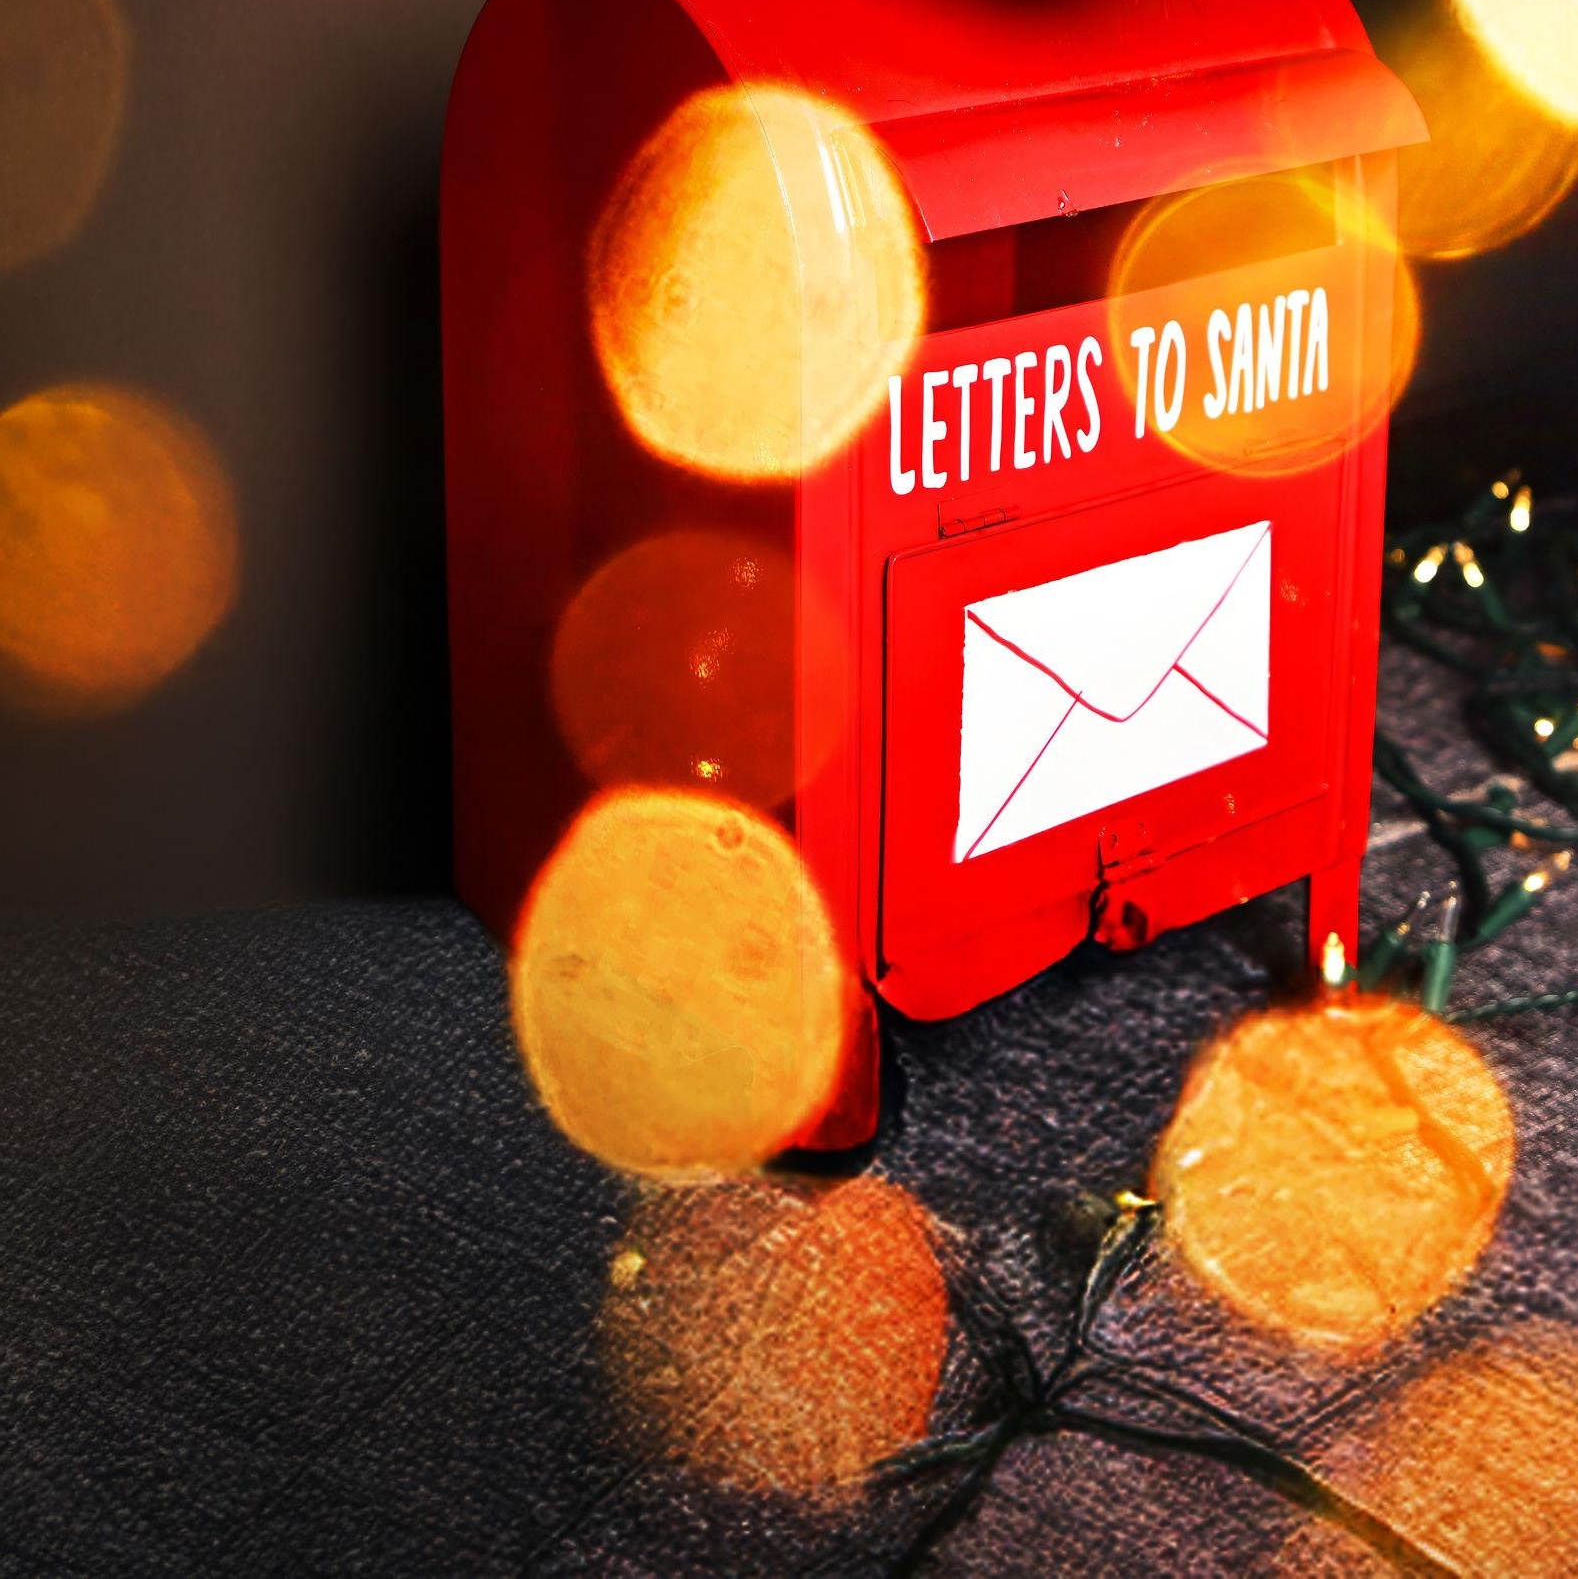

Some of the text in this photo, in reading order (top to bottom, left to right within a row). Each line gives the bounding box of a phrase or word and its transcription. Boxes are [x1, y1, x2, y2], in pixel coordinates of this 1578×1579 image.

[888, 287, 1329, 495] LETTERS TO SANTA
